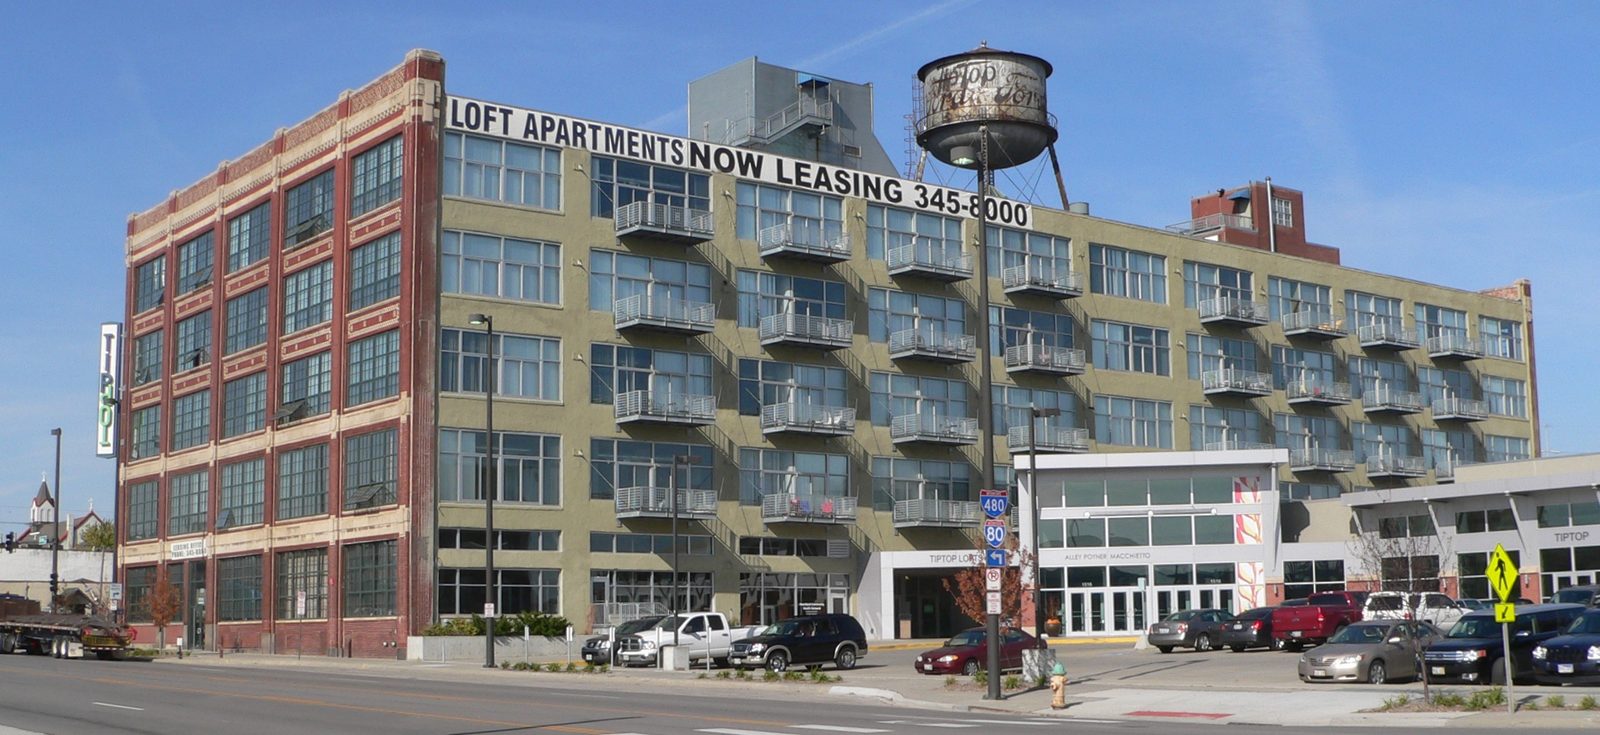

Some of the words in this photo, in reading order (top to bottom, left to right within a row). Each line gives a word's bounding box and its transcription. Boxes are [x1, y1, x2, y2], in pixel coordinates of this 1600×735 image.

[451, 99, 513, 135] LOFT
[524, 113, 684, 165] APARTMENTS
[690, 142, 763, 178] NOW
[776, 158, 902, 203] LEASING
[914, 184, 1028, 227] 345-8000
[985, 498, 1005, 512] 480
[986, 527, 1003, 542] 80
[1554, 531, 1589, 542] TIPTOP
[929, 554, 957, 563] TIPTOP
[959, 554, 983, 563] LOTS
